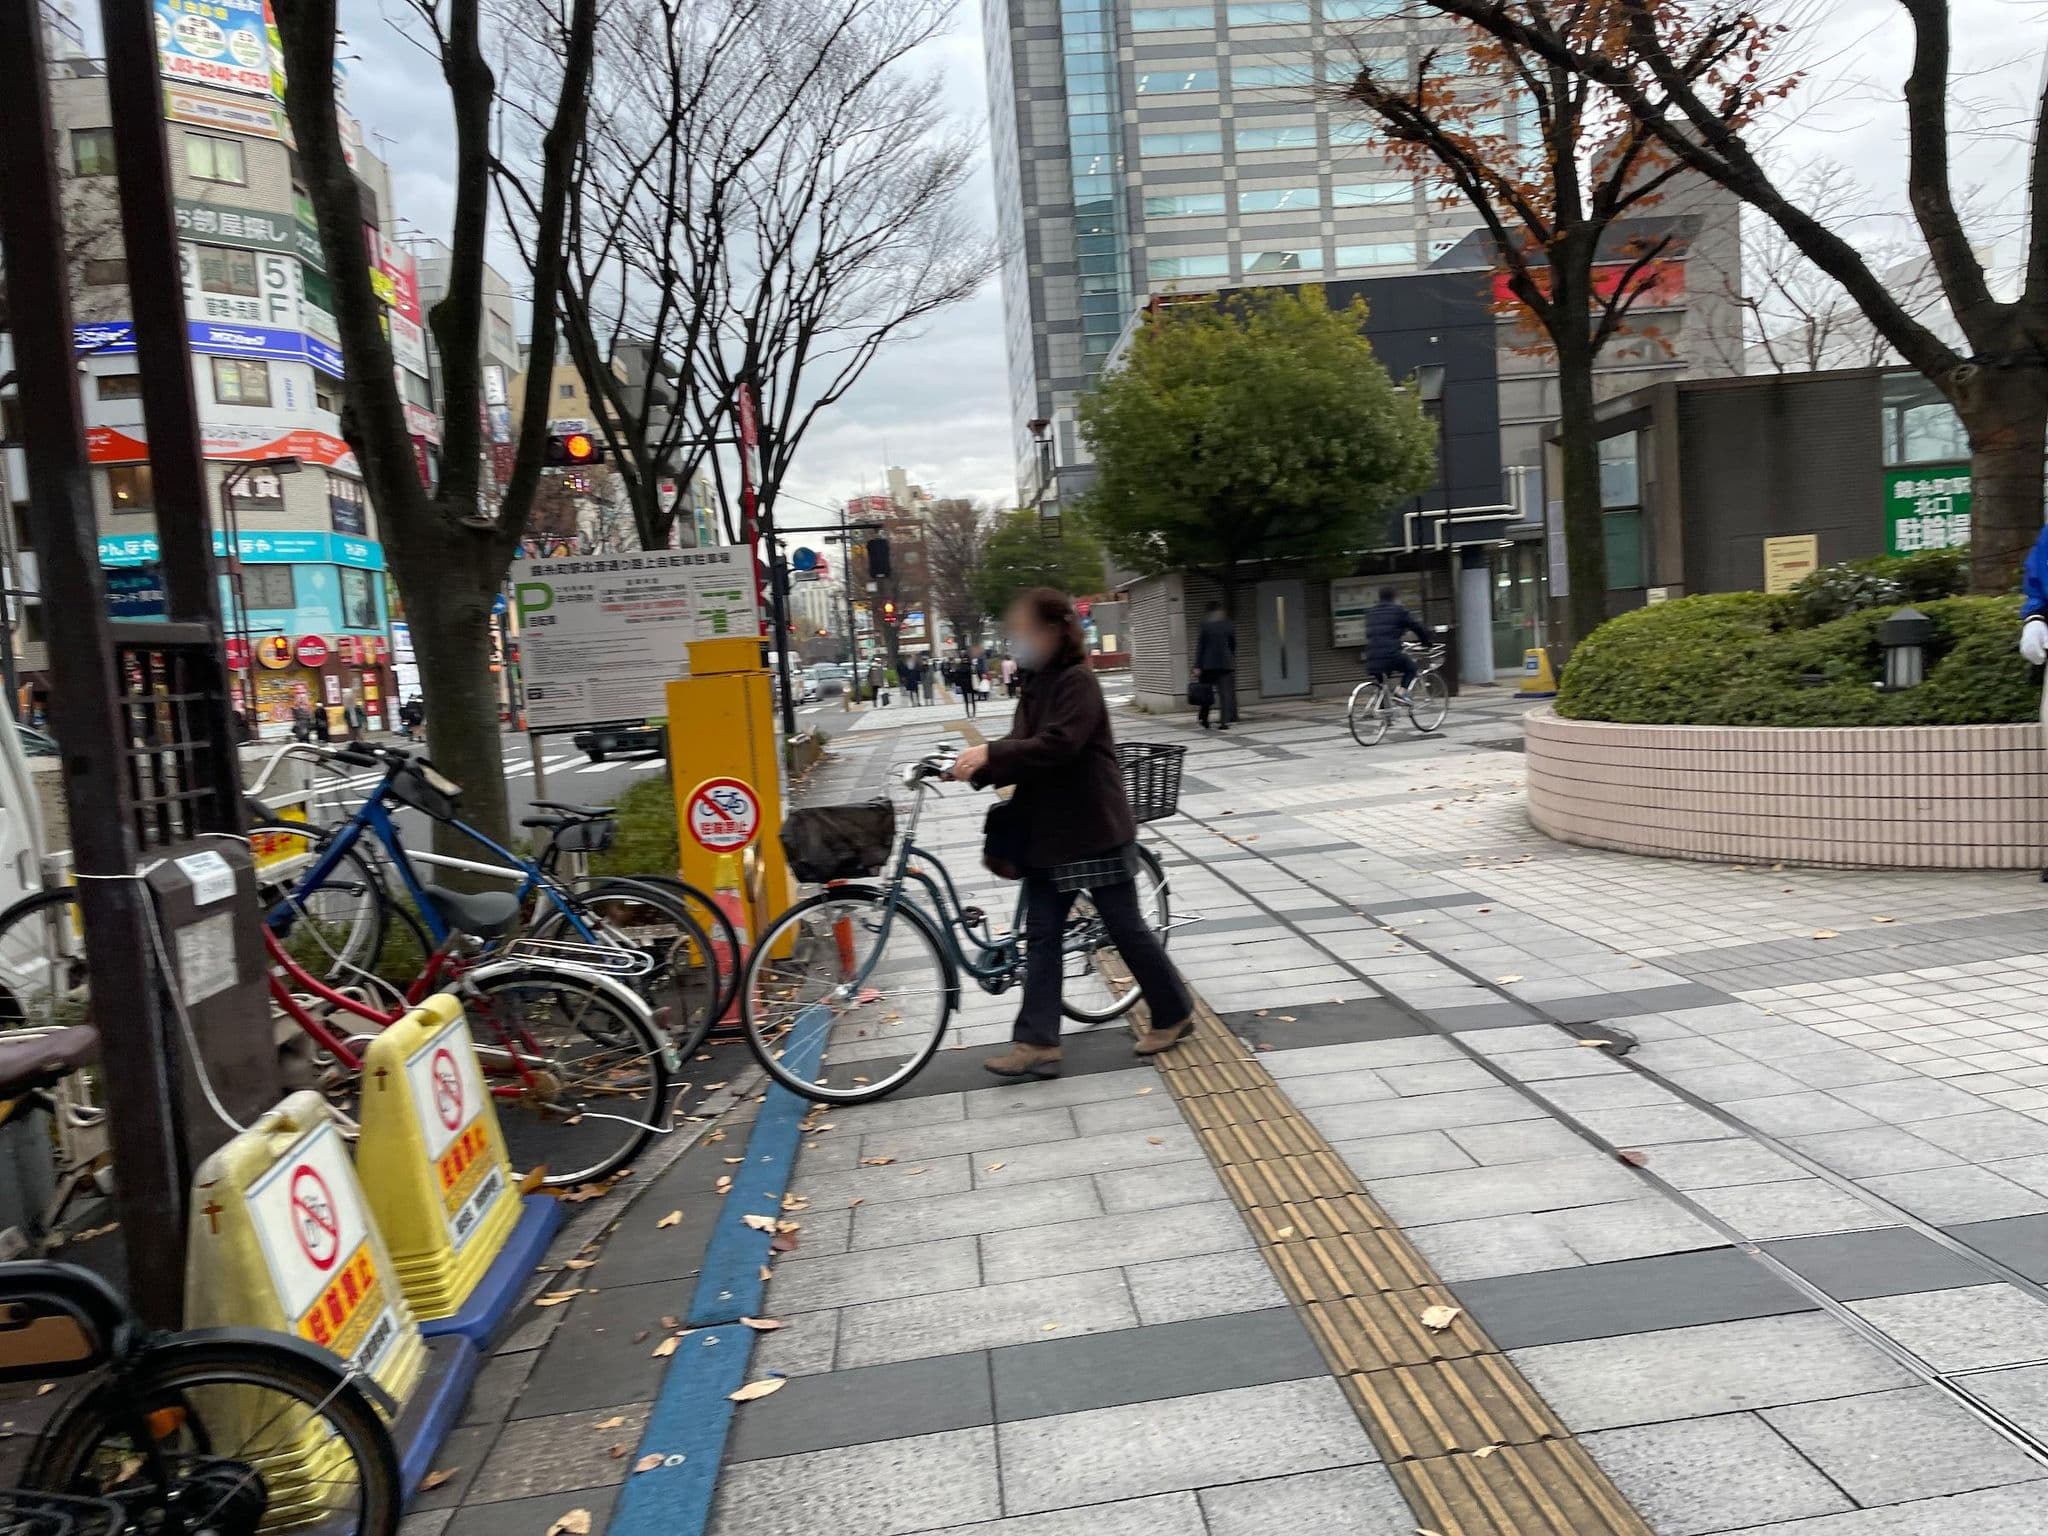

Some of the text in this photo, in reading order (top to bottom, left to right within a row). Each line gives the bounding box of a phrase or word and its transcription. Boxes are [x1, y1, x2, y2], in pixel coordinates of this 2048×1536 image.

[1913, 496, 1953, 515] 北口
[1895, 513, 1972, 551] 駐輪場
[515, 582, 555, 629] P
